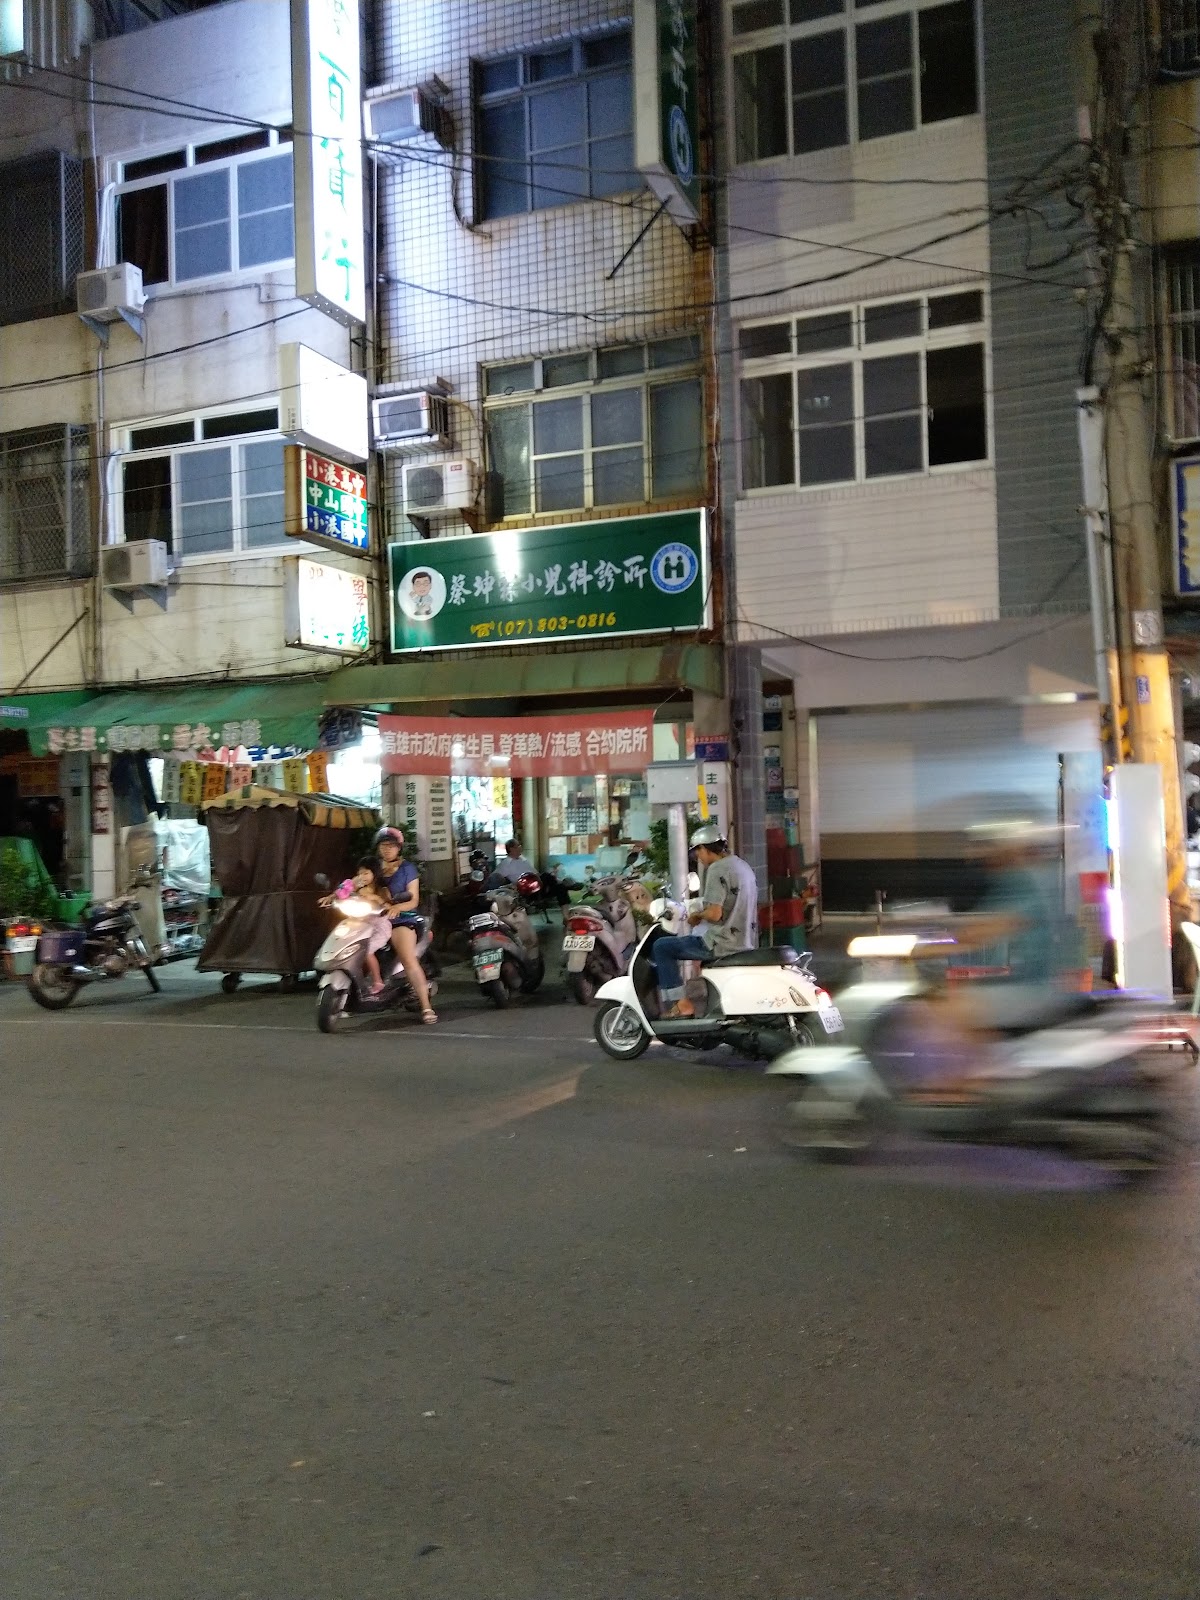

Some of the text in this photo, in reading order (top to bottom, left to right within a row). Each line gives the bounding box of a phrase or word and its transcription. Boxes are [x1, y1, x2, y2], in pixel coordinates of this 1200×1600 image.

[383, 730, 495, 759] 高雄市政府衛生局
[499, 731, 582, 759] 登革熱/流感
[585, 726, 648, 757] 合約院所
